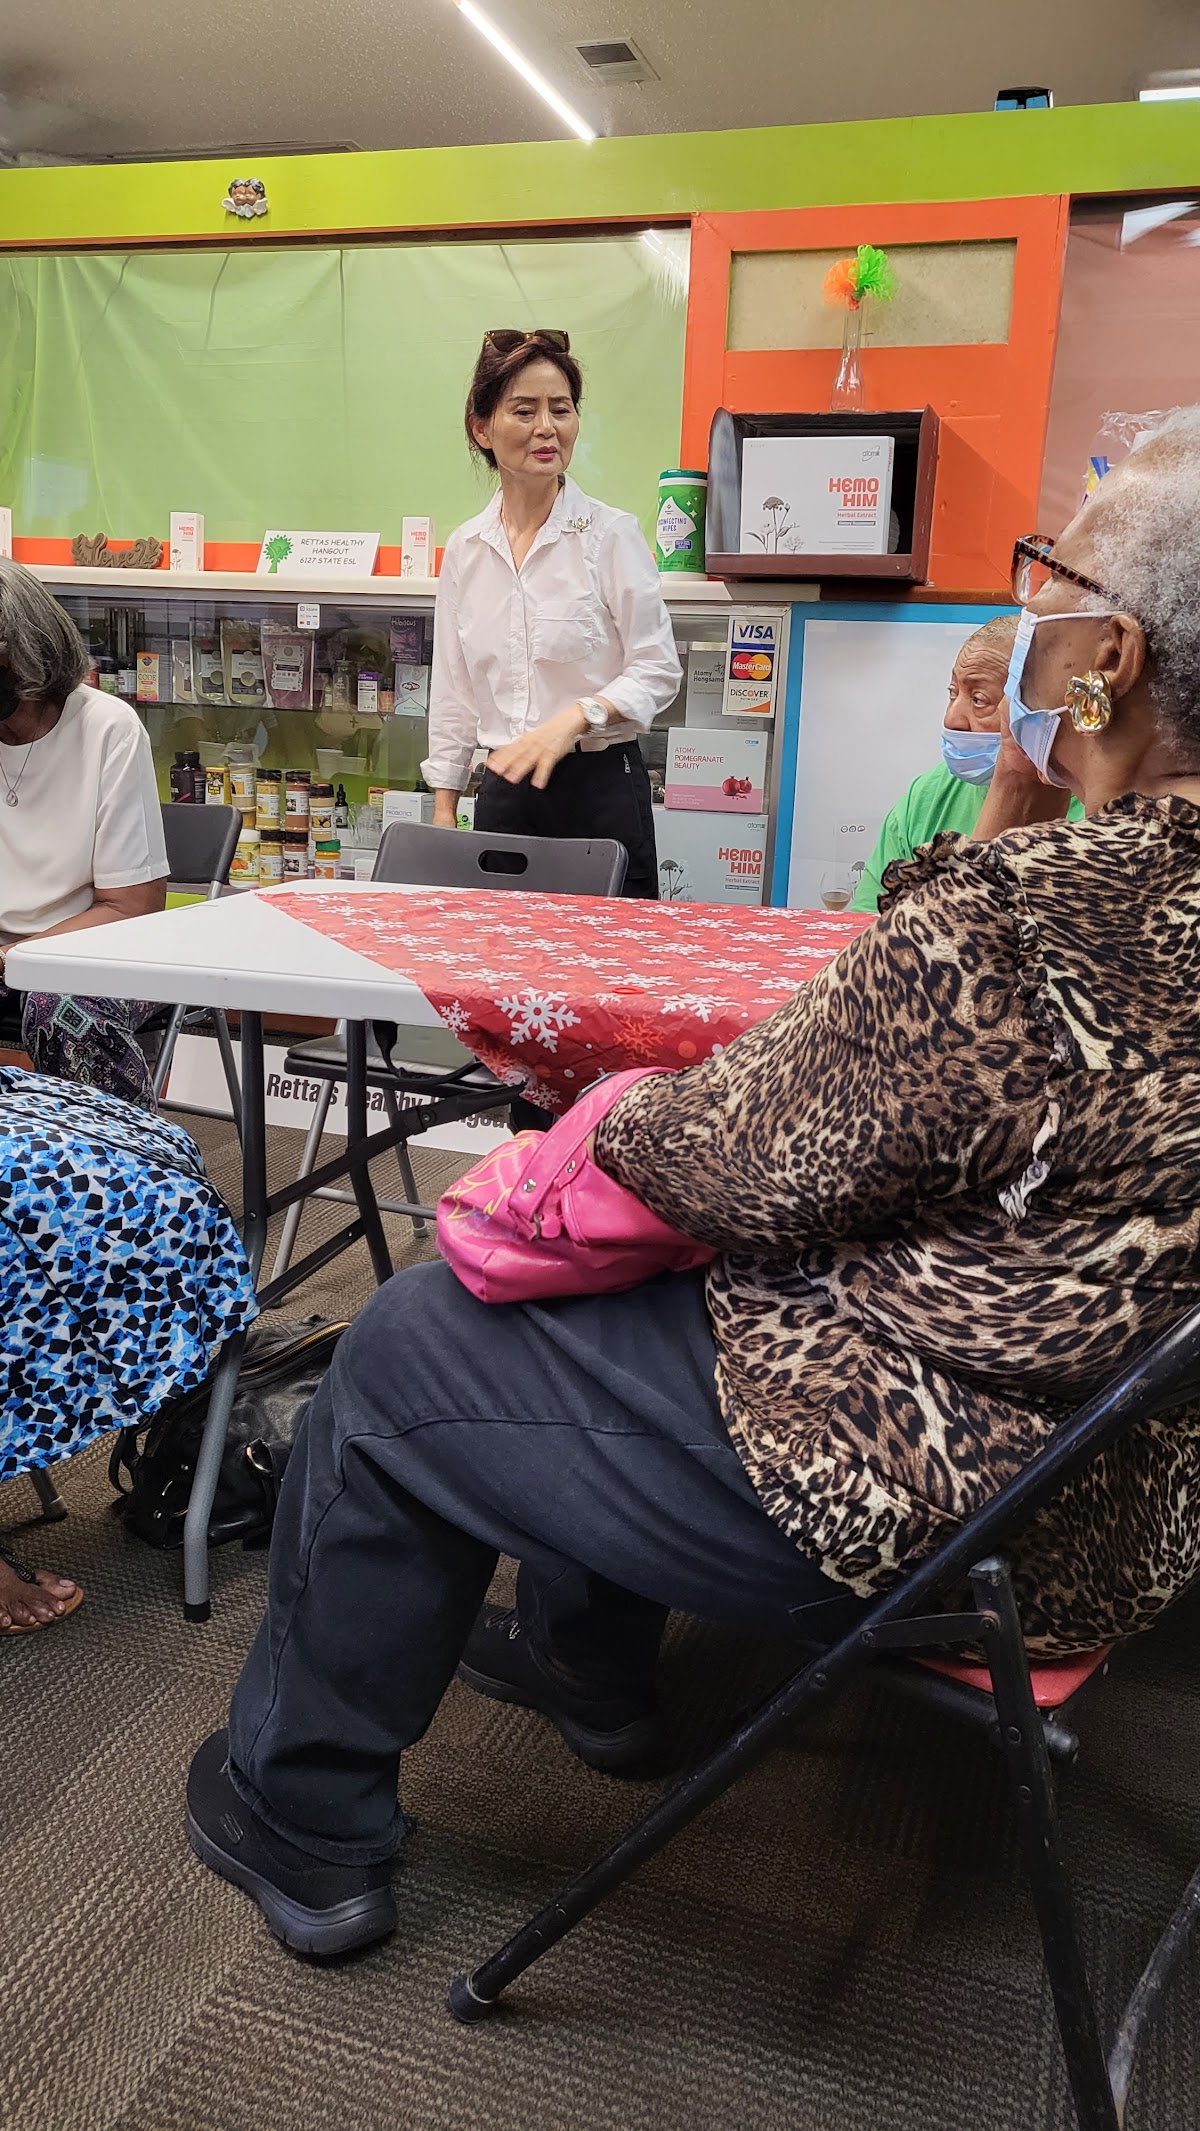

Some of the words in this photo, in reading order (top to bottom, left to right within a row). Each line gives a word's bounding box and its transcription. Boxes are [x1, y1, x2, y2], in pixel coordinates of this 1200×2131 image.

[829, 477, 879, 493] HEMO
[843, 494, 878, 507] HIM
[301, 538, 329, 546] RETTAS
[330, 539, 365, 547] HEALTHY
[312, 547, 350, 555] HANGOUT
[317, 557, 342, 565] STATE
[737, 623, 774, 639] VISA
[732, 661, 771, 671] MasterCard
[730, 688, 769, 699] DISCOVER
[674, 754, 724, 764] POMEGRANATE
[674, 762, 700, 770] BEAUTY
[718, 847, 763, 863] HEMO
[730, 861, 761, 875] HIM
[266, 1073, 339, 1106] Rettas
